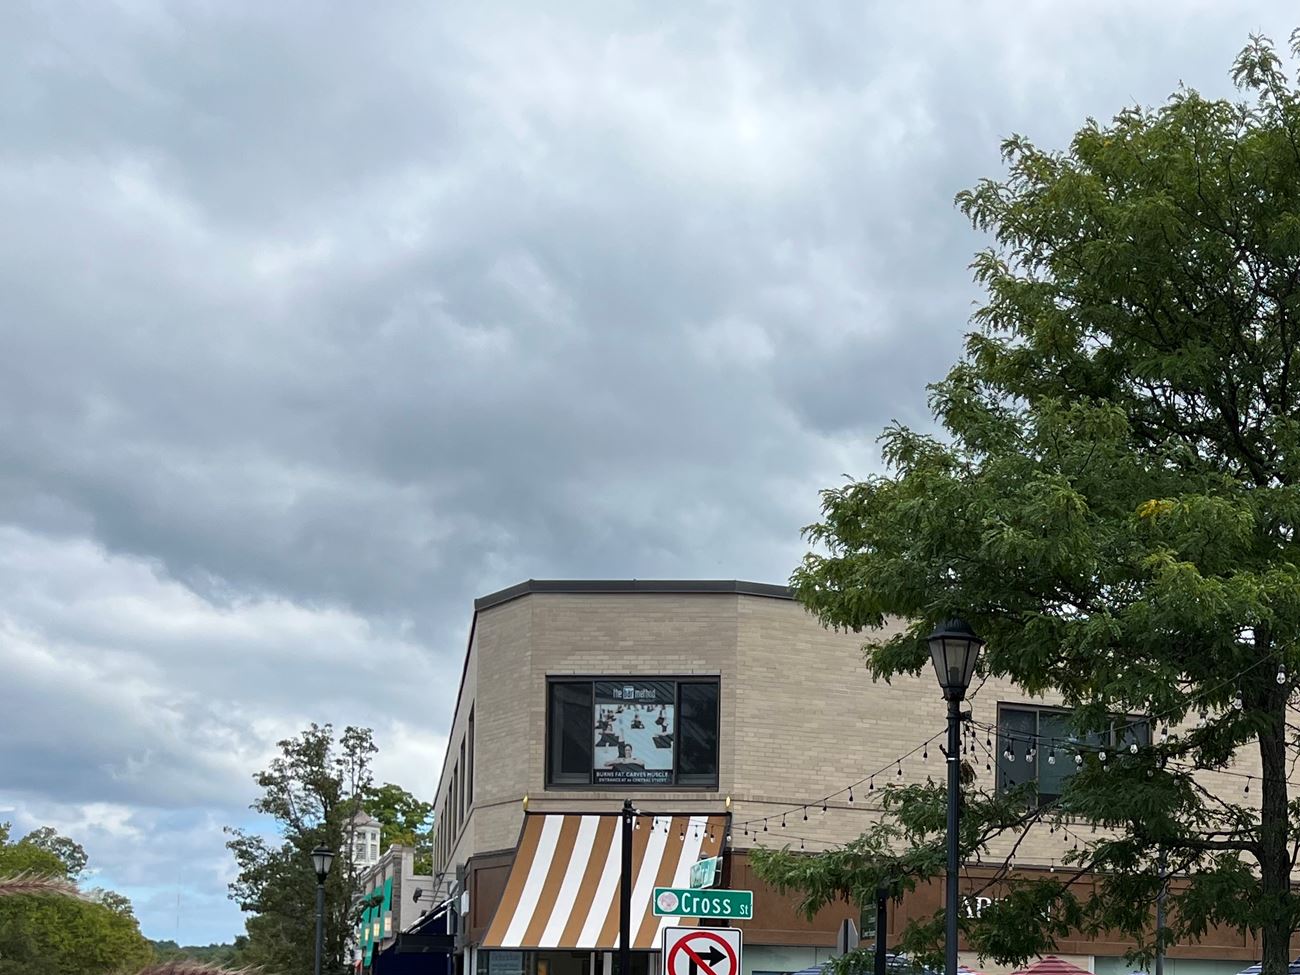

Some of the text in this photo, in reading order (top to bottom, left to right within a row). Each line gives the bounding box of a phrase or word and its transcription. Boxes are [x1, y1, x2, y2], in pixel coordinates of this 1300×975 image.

[613, 687, 656, 698] the bar method
[681, 892, 749, 915] Cross St
